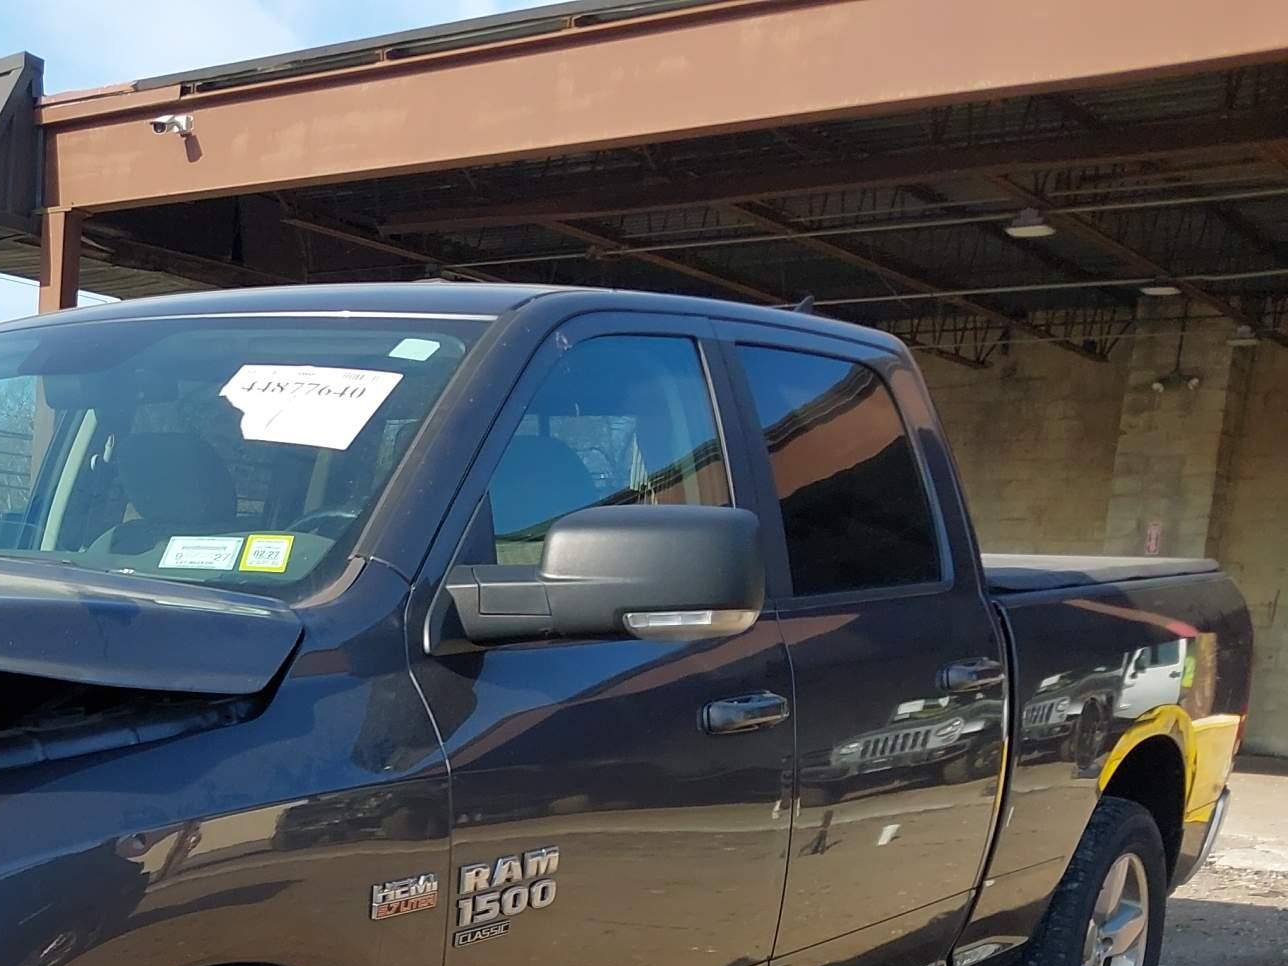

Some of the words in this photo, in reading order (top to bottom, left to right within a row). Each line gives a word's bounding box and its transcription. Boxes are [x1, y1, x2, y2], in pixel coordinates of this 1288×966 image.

[241, 380, 368, 400] 44877640
[459, 845, 560, 895] RAM
[373, 873, 439, 903] HEMI
[400, 896, 434, 912] LITER
[457, 878, 557, 928] 1500
[458, 921, 510, 945] CLASSIC
